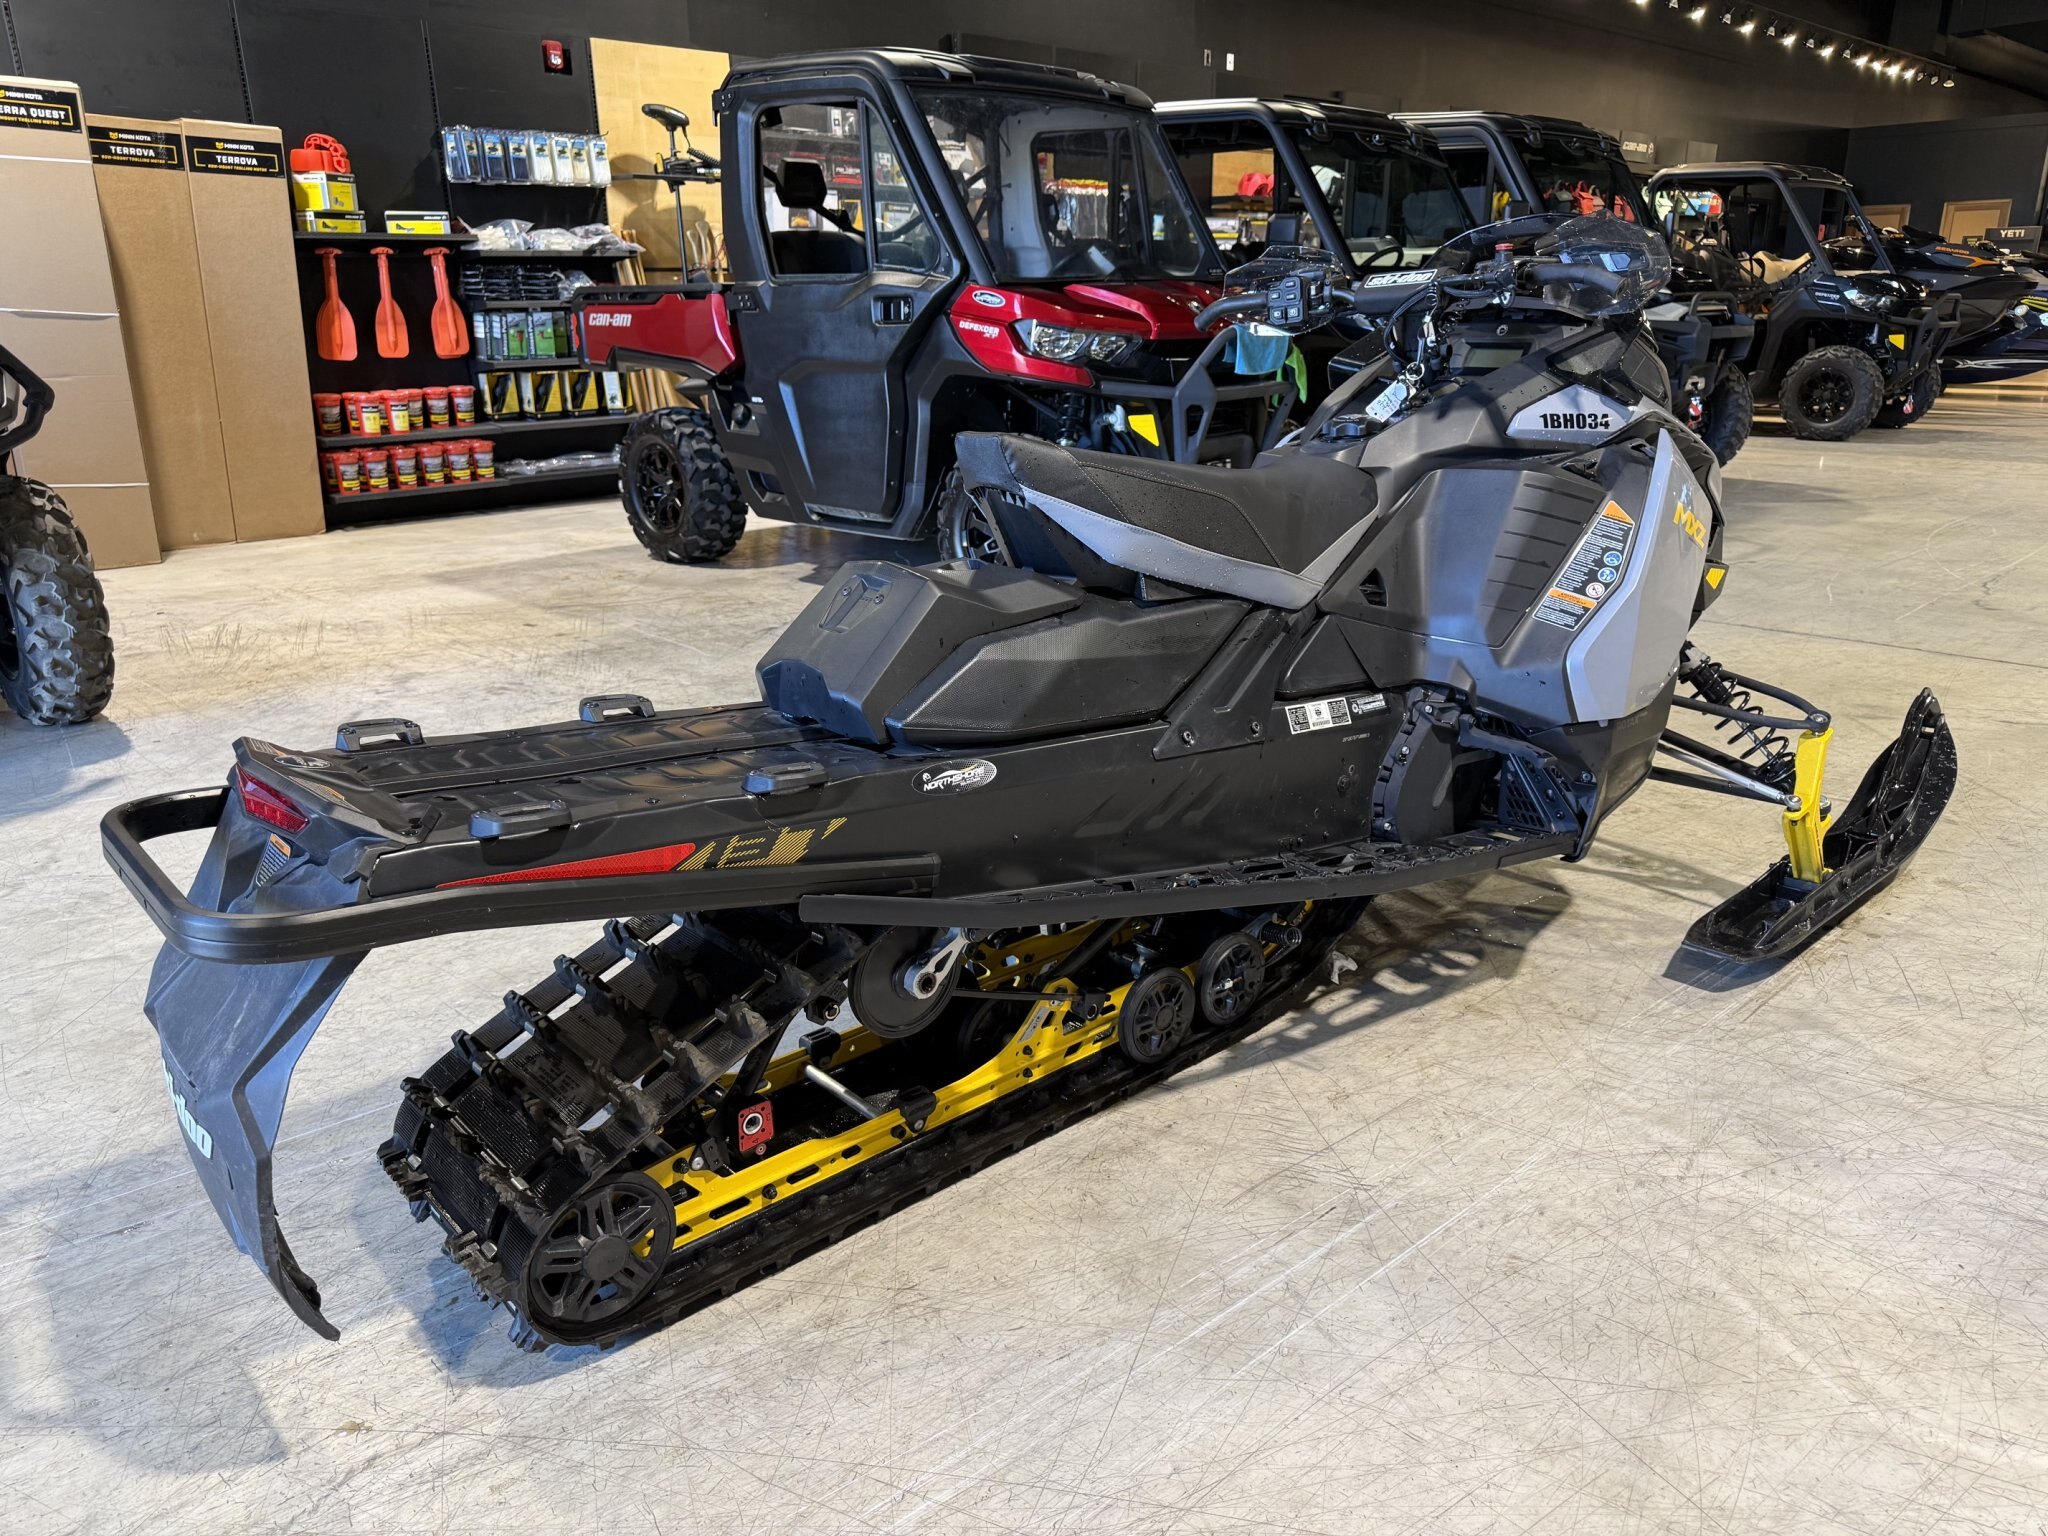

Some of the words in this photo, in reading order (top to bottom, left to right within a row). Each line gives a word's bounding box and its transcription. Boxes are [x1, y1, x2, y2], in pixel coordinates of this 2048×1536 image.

[25, 92, 43, 100] KOTA
[30, 107, 66, 119] QUEST
[109, 145, 156, 157] TERROVA
[215, 155, 258, 166] TERROVA
[2000, 229, 2025, 238] YETI
[1367, 272, 1433, 286] ski-doo
[588, 313, 632, 327] can-am
[959, 320, 999, 335] DEFENDER
[1539, 413, 1611, 430] 1BH034
[923, 765, 985, 792] NORTHSHORE
